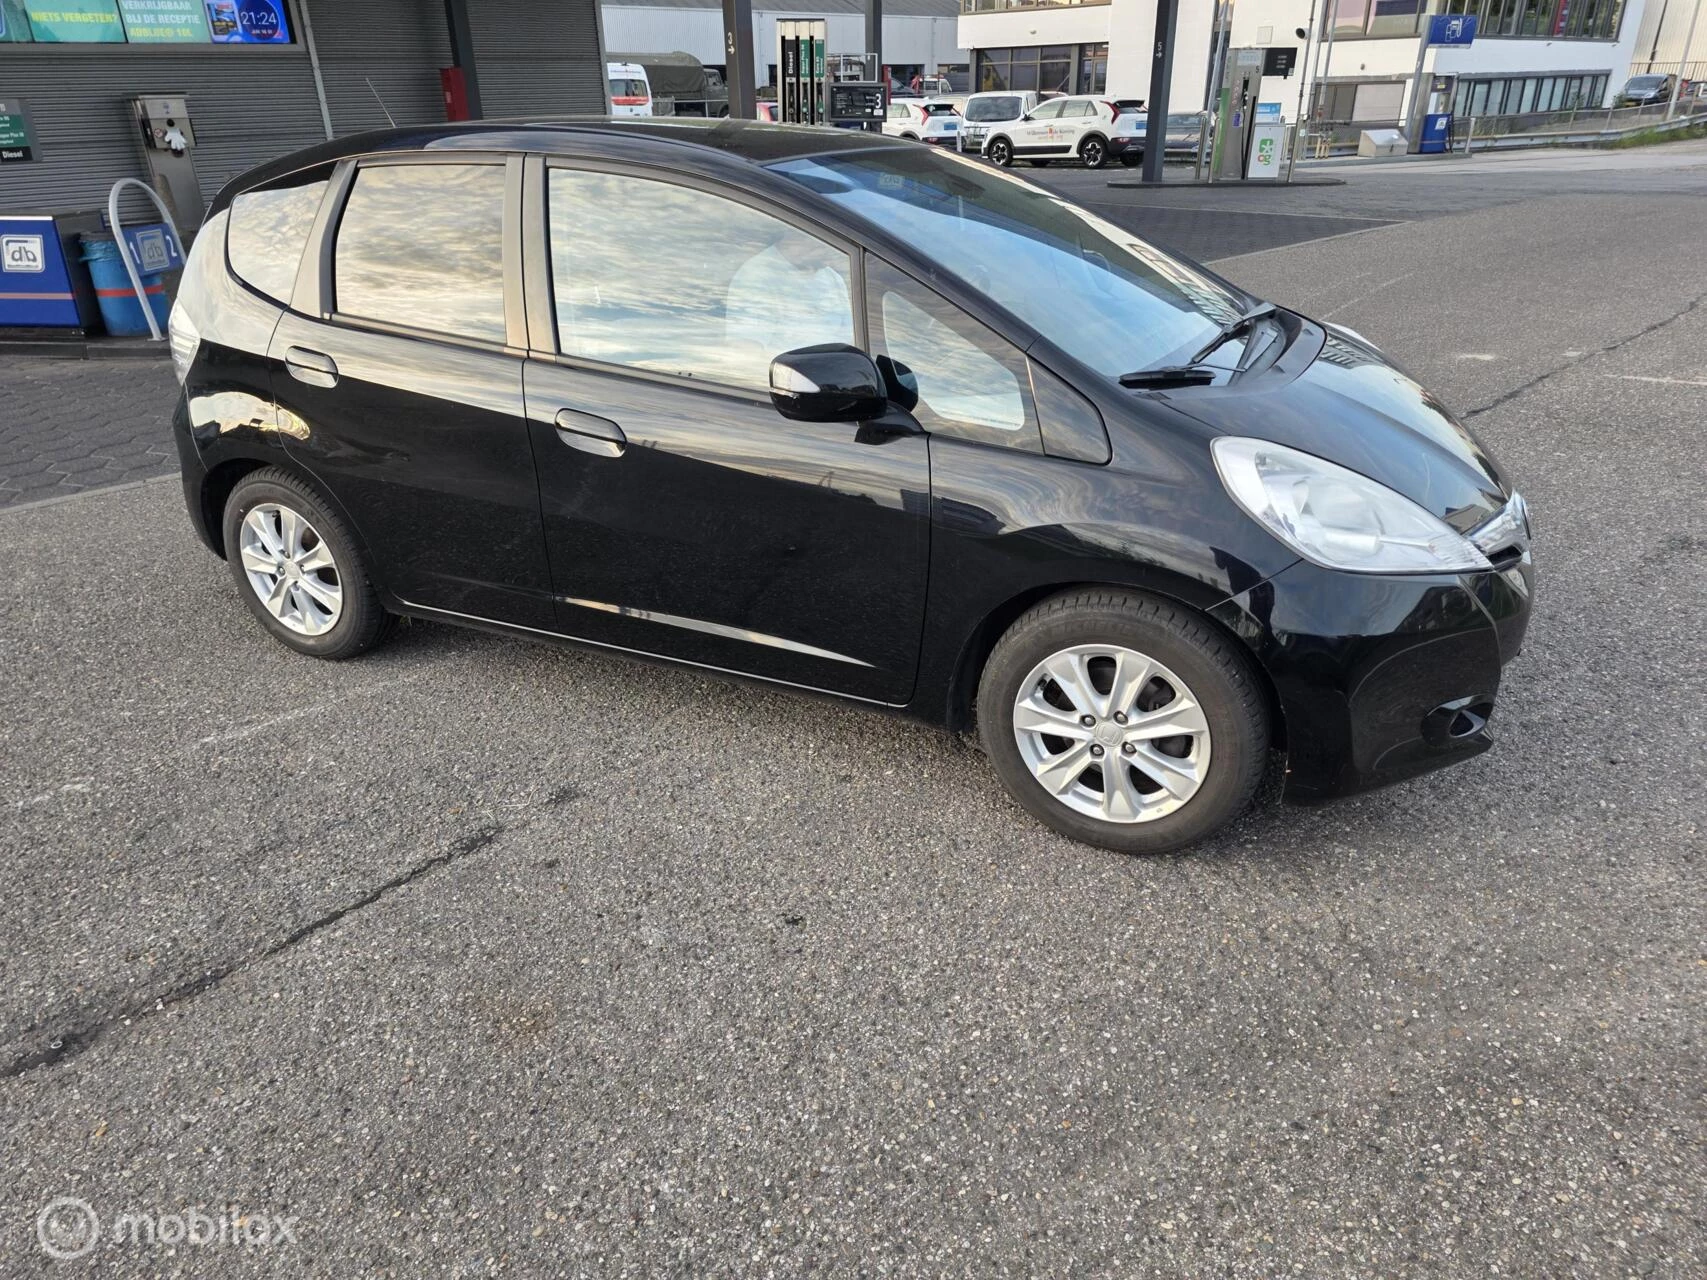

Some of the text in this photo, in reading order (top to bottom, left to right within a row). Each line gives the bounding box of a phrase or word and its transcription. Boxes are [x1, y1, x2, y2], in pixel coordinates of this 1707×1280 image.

[121, 0, 193, 10] VERKRIJGBAAR
[31, 11, 60, 22] NIETS
[126, 14, 201, 24] BIJ DE RECEPTIE
[240, 11, 277, 25] 21:24
[727, 31, 733, 45] 3
[875, 93, 882, 109] 3
[2, 150, 24, 159] Diesel
[165, 235, 178, 257] 2
[11, 246, 37, 263] db
